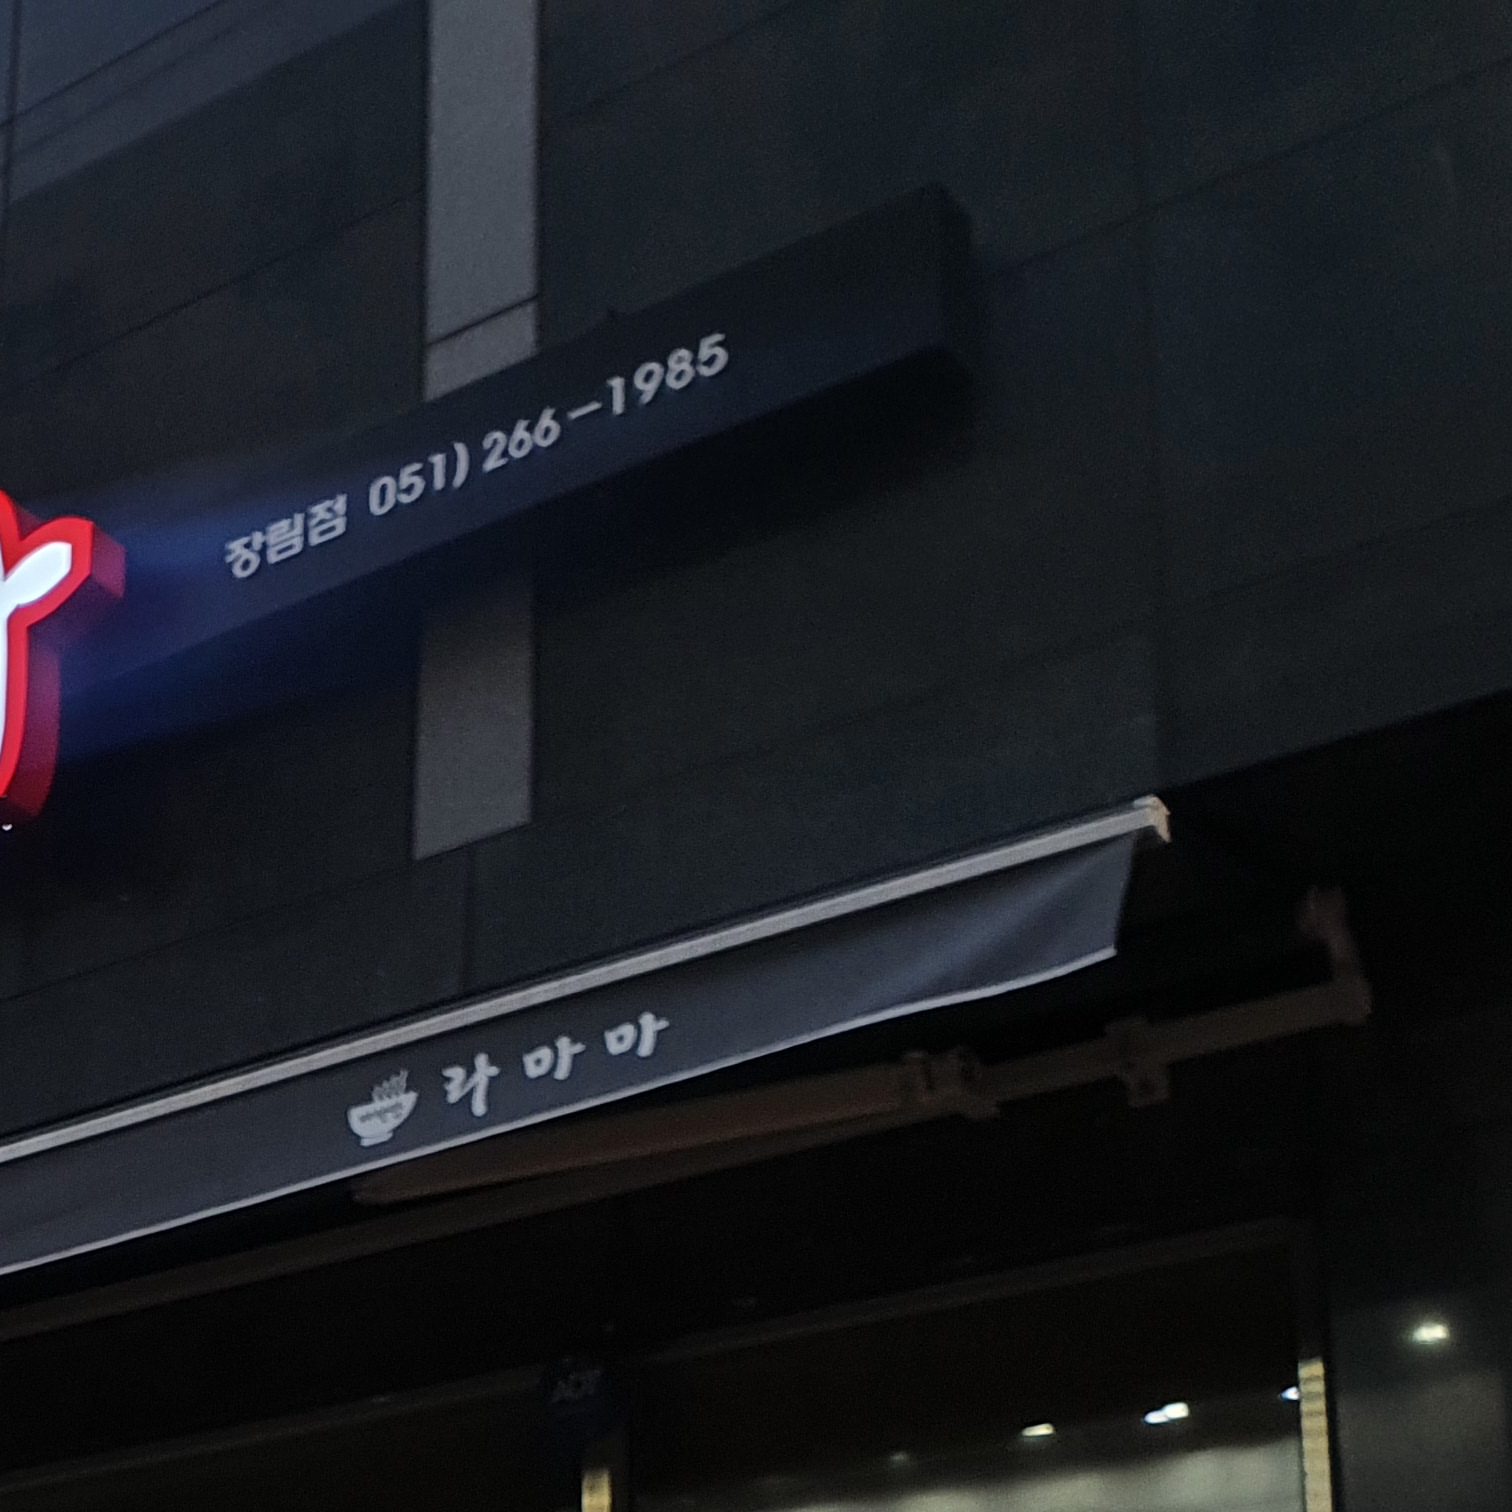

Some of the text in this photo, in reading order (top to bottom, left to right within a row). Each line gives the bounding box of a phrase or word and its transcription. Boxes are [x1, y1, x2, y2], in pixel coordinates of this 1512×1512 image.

[225, 332, 730, 579] 장림점 051) 266-1985
[441, 1010, 670, 1118] 라마마
